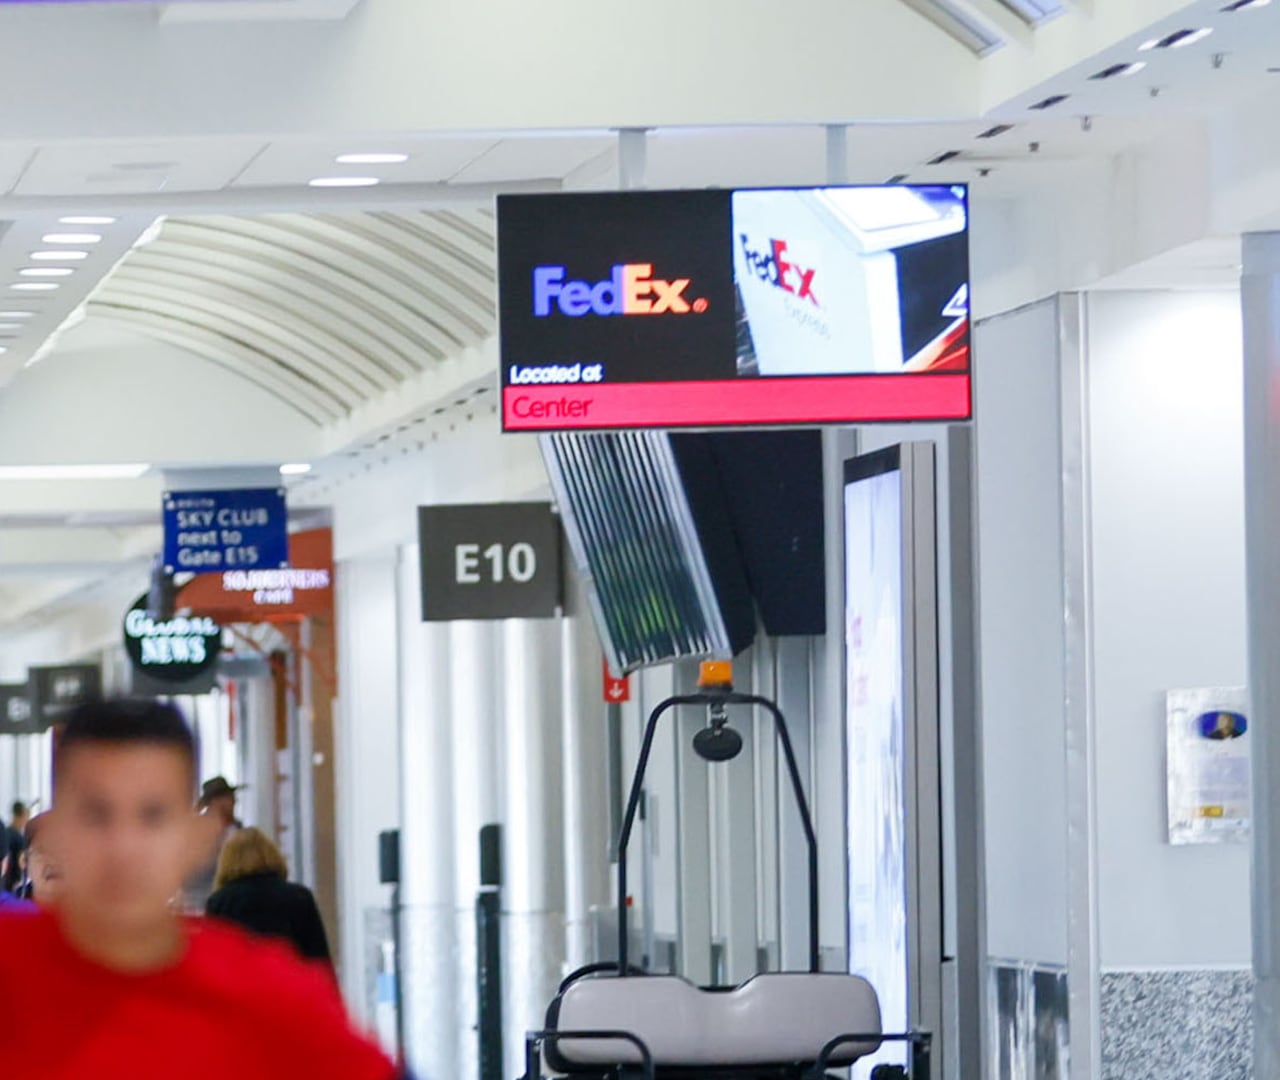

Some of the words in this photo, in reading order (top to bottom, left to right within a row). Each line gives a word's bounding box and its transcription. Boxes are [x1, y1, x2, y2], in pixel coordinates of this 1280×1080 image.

[510, 363, 580, 384] Located
[581, 363, 602, 382] at
[512, 396, 593, 418] Center
[176, 510, 213, 528] SKY
[217, 508, 268, 526] CLUB
[177, 531, 218, 546] next
[221, 529, 242, 545] to
[177, 548, 222, 566] Gate
[225, 546, 258, 565] E15
[455, 543, 537, 583] E10
[141, 636, 206, 664] NEWS
